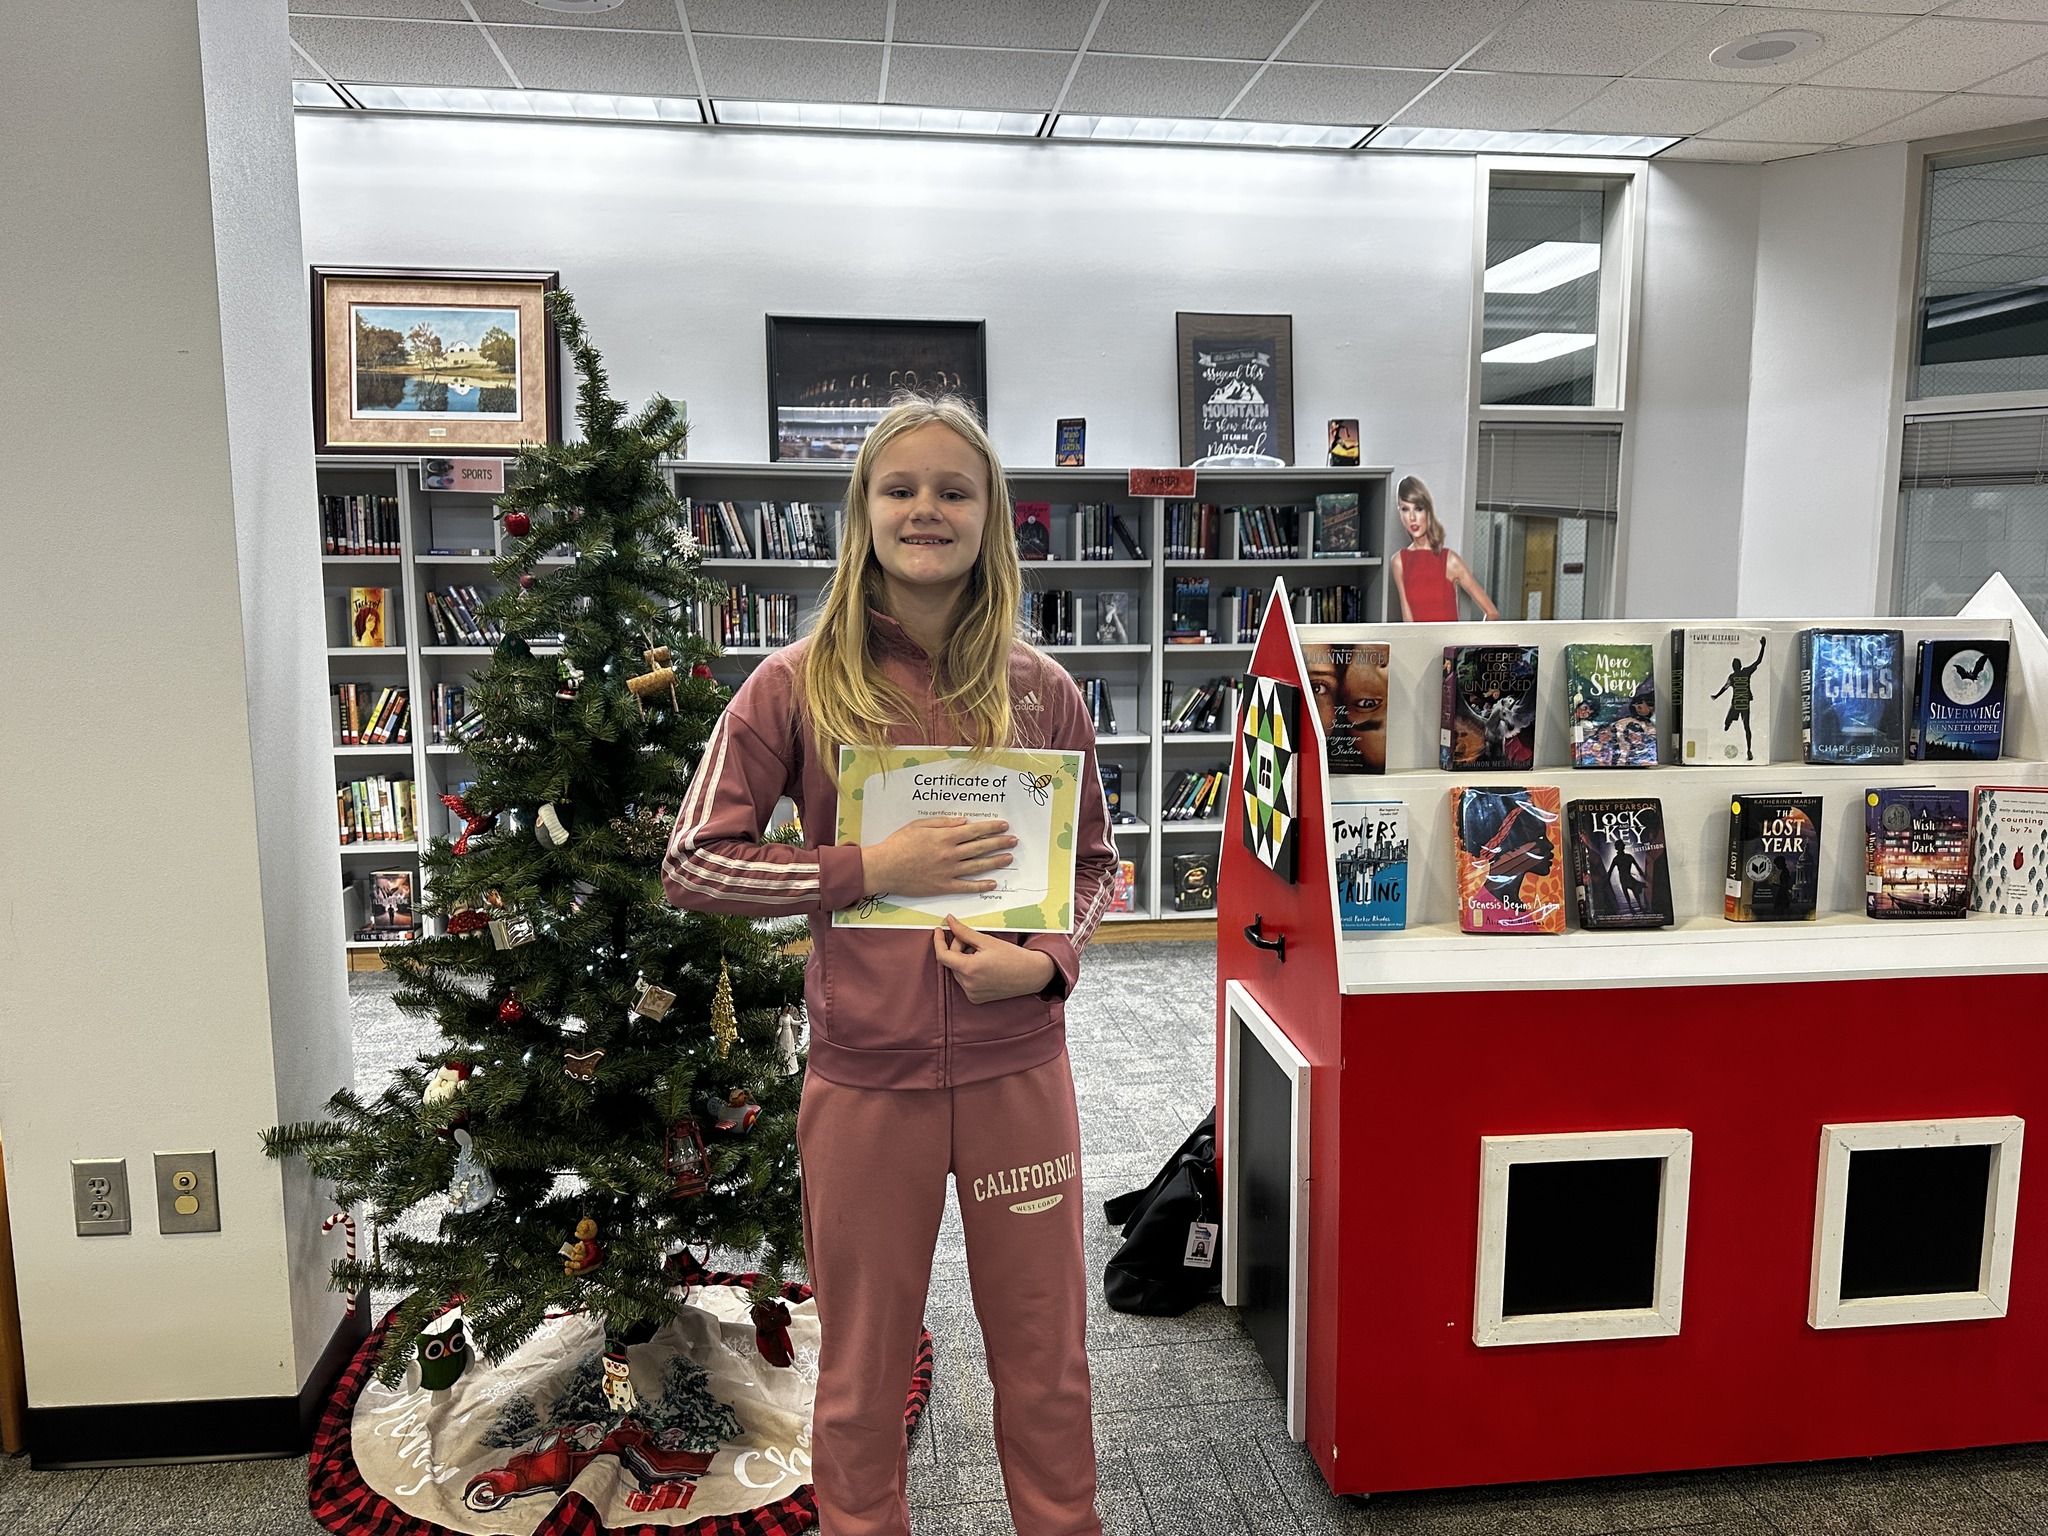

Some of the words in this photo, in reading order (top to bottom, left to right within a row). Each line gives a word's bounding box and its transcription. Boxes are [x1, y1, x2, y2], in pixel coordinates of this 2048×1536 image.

[1202, 403, 1269, 418] MOUNTAIN
[1202, 418, 1214, 430] to
[1216, 418, 1239, 433] show
[1241, 418, 1267, 432] others
[461, 468, 493, 481] SPORTS
[1356, 652, 1385, 665] RICE
[1481, 653, 1521, 662] KEEPER
[1595, 653, 1631, 672] More
[1486, 662, 1514, 672] LOST
[1612, 669, 1619, 678] to
[1620, 669, 1632, 678] the
[1481, 672, 1516, 681] CITIES
[1801, 669, 1811, 692] COLD
[1464, 680, 1532, 692] UNLOCKED
[1590, 672, 1640, 697] Story
[1671, 669, 1683, 706] BOOKED
[1825, 668, 1893, 700] CALLS
[1733, 676, 1749, 711] BOOKED
[1014, 703, 1045, 712] adidas
[1333, 705, 1350, 715] The
[1801, 694, 1811, 722] CALLS
[1929, 702, 2001, 719] SILVERWING
[1327, 719, 1356, 730] Secret
[1929, 724, 1971, 736] KENNETH
[1973, 724, 1999, 734] OPPEL
[1331, 745, 1363, 756] Sisters
[1818, 744, 1862, 753] CHARLES
[1864, 744, 1900, 754] BENOIT
[1491, 760, 1531, 768] MESSENGER
[914, 773, 990, 787] Certificate
[992, 775, 1007, 788] of
[912, 788, 1006, 803] Achievement
[1578, 804, 1610, 812] RIDLEY
[1614, 803, 1657, 811] PEARSON
[1776, 809, 1795, 818] THE
[1921, 809, 1928, 818] A
[1591, 807, 1656, 833] LOCK
[1913, 819, 1936, 831] Wish
[2001, 817, 2044, 826] counting
[1332, 820, 1397, 844] TOWERS
[1762, 819, 1805, 836] LOST
[2010, 826, 2021, 834] by
[2024, 826, 2033, 834] 7s
[1604, 824, 1646, 846] KEY
[1913, 832, 1921, 840] in
[1631, 844, 1664, 853] INITIATION
[1761, 837, 1804, 853] YEAR
[1912, 841, 1936, 853] Dark
[1730, 851, 1738, 871] LOST
[1338, 881, 1401, 903] FALLING
[1468, 895, 1501, 910] Genesis
[1503, 894, 1532, 916] Begins
[973, 1151, 1077, 1202] CALIFORNIA
[1016, 1203, 1036, 1213] WEST
[1037, 1196, 1059, 1209] COAST
